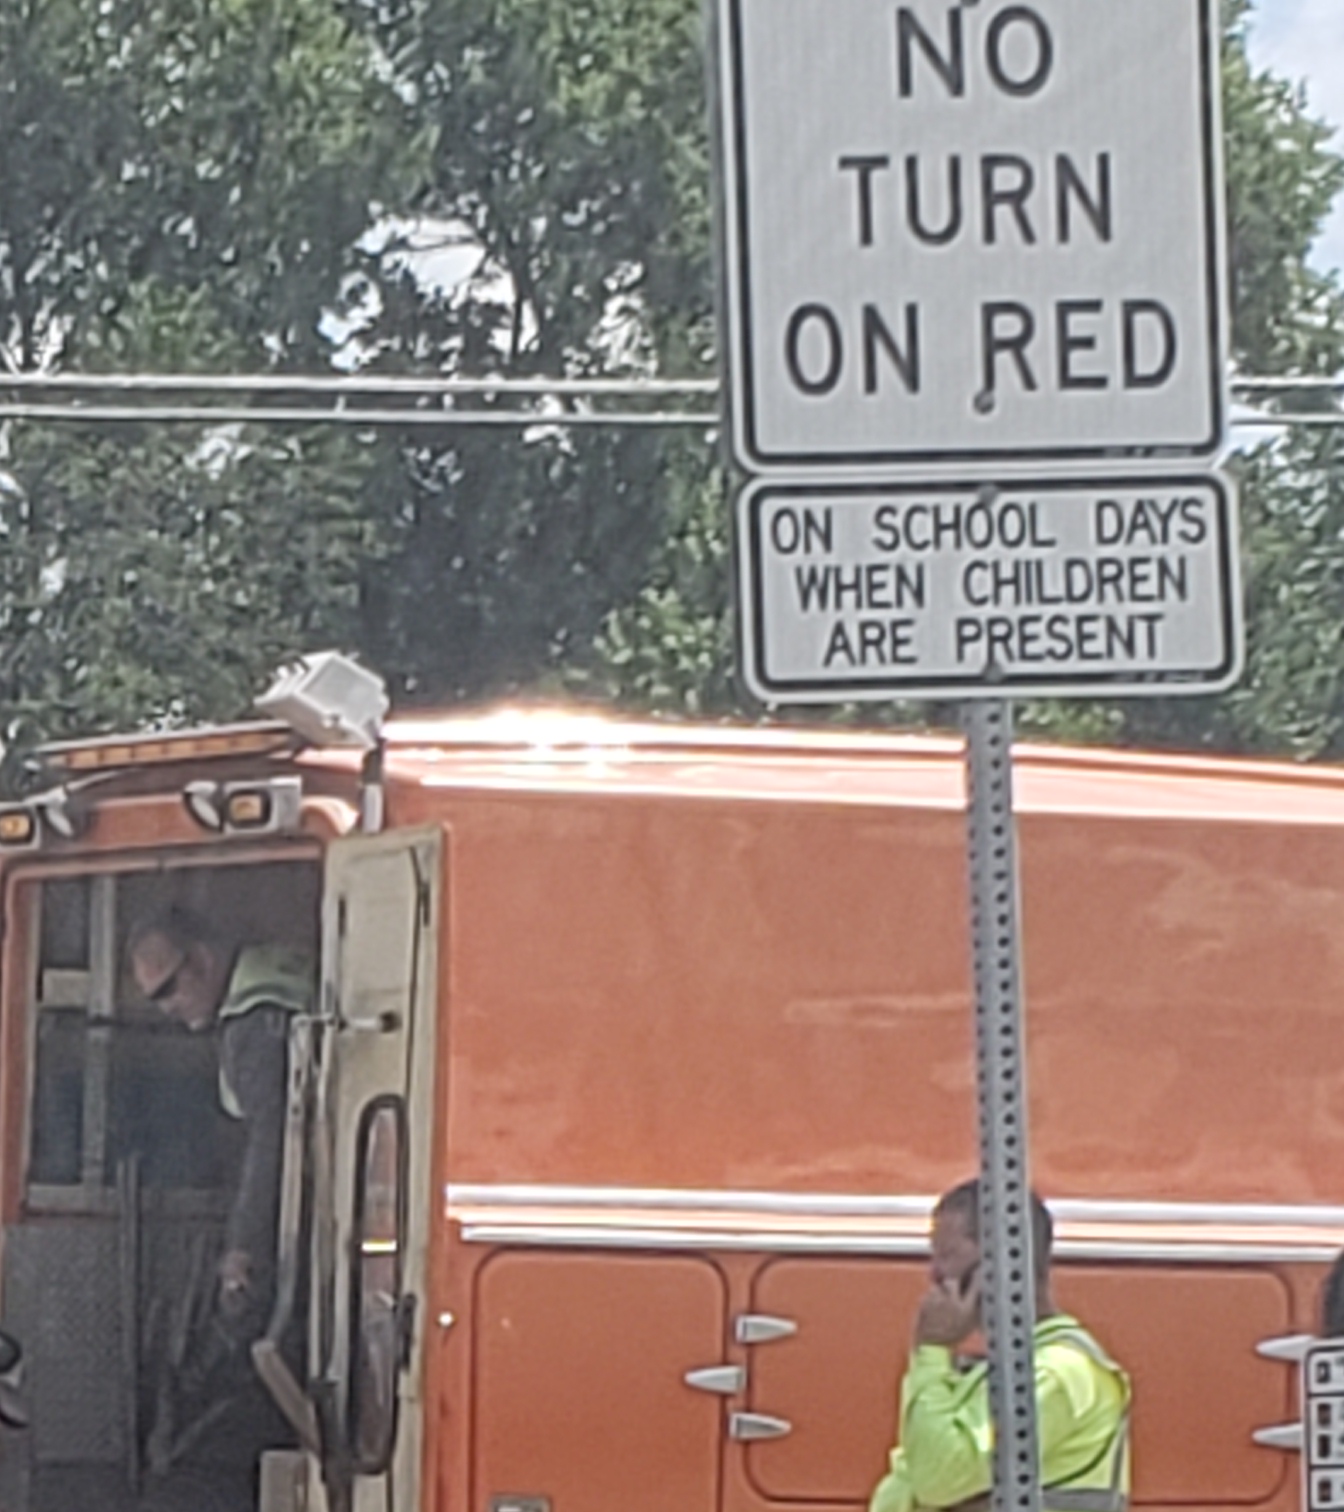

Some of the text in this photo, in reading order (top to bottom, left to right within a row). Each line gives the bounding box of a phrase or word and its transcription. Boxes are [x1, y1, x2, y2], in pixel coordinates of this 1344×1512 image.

[896, 5, 1053, 98] NO
[838, 152, 1111, 247] TURN
[785, 300, 1177, 396] ON RED
[771, 498, 1207, 554] ON SCHOOL DAYS
[794, 556, 1187, 613] WHEN CHILDREN
[823, 613, 1164, 669] ARE PRESENT
